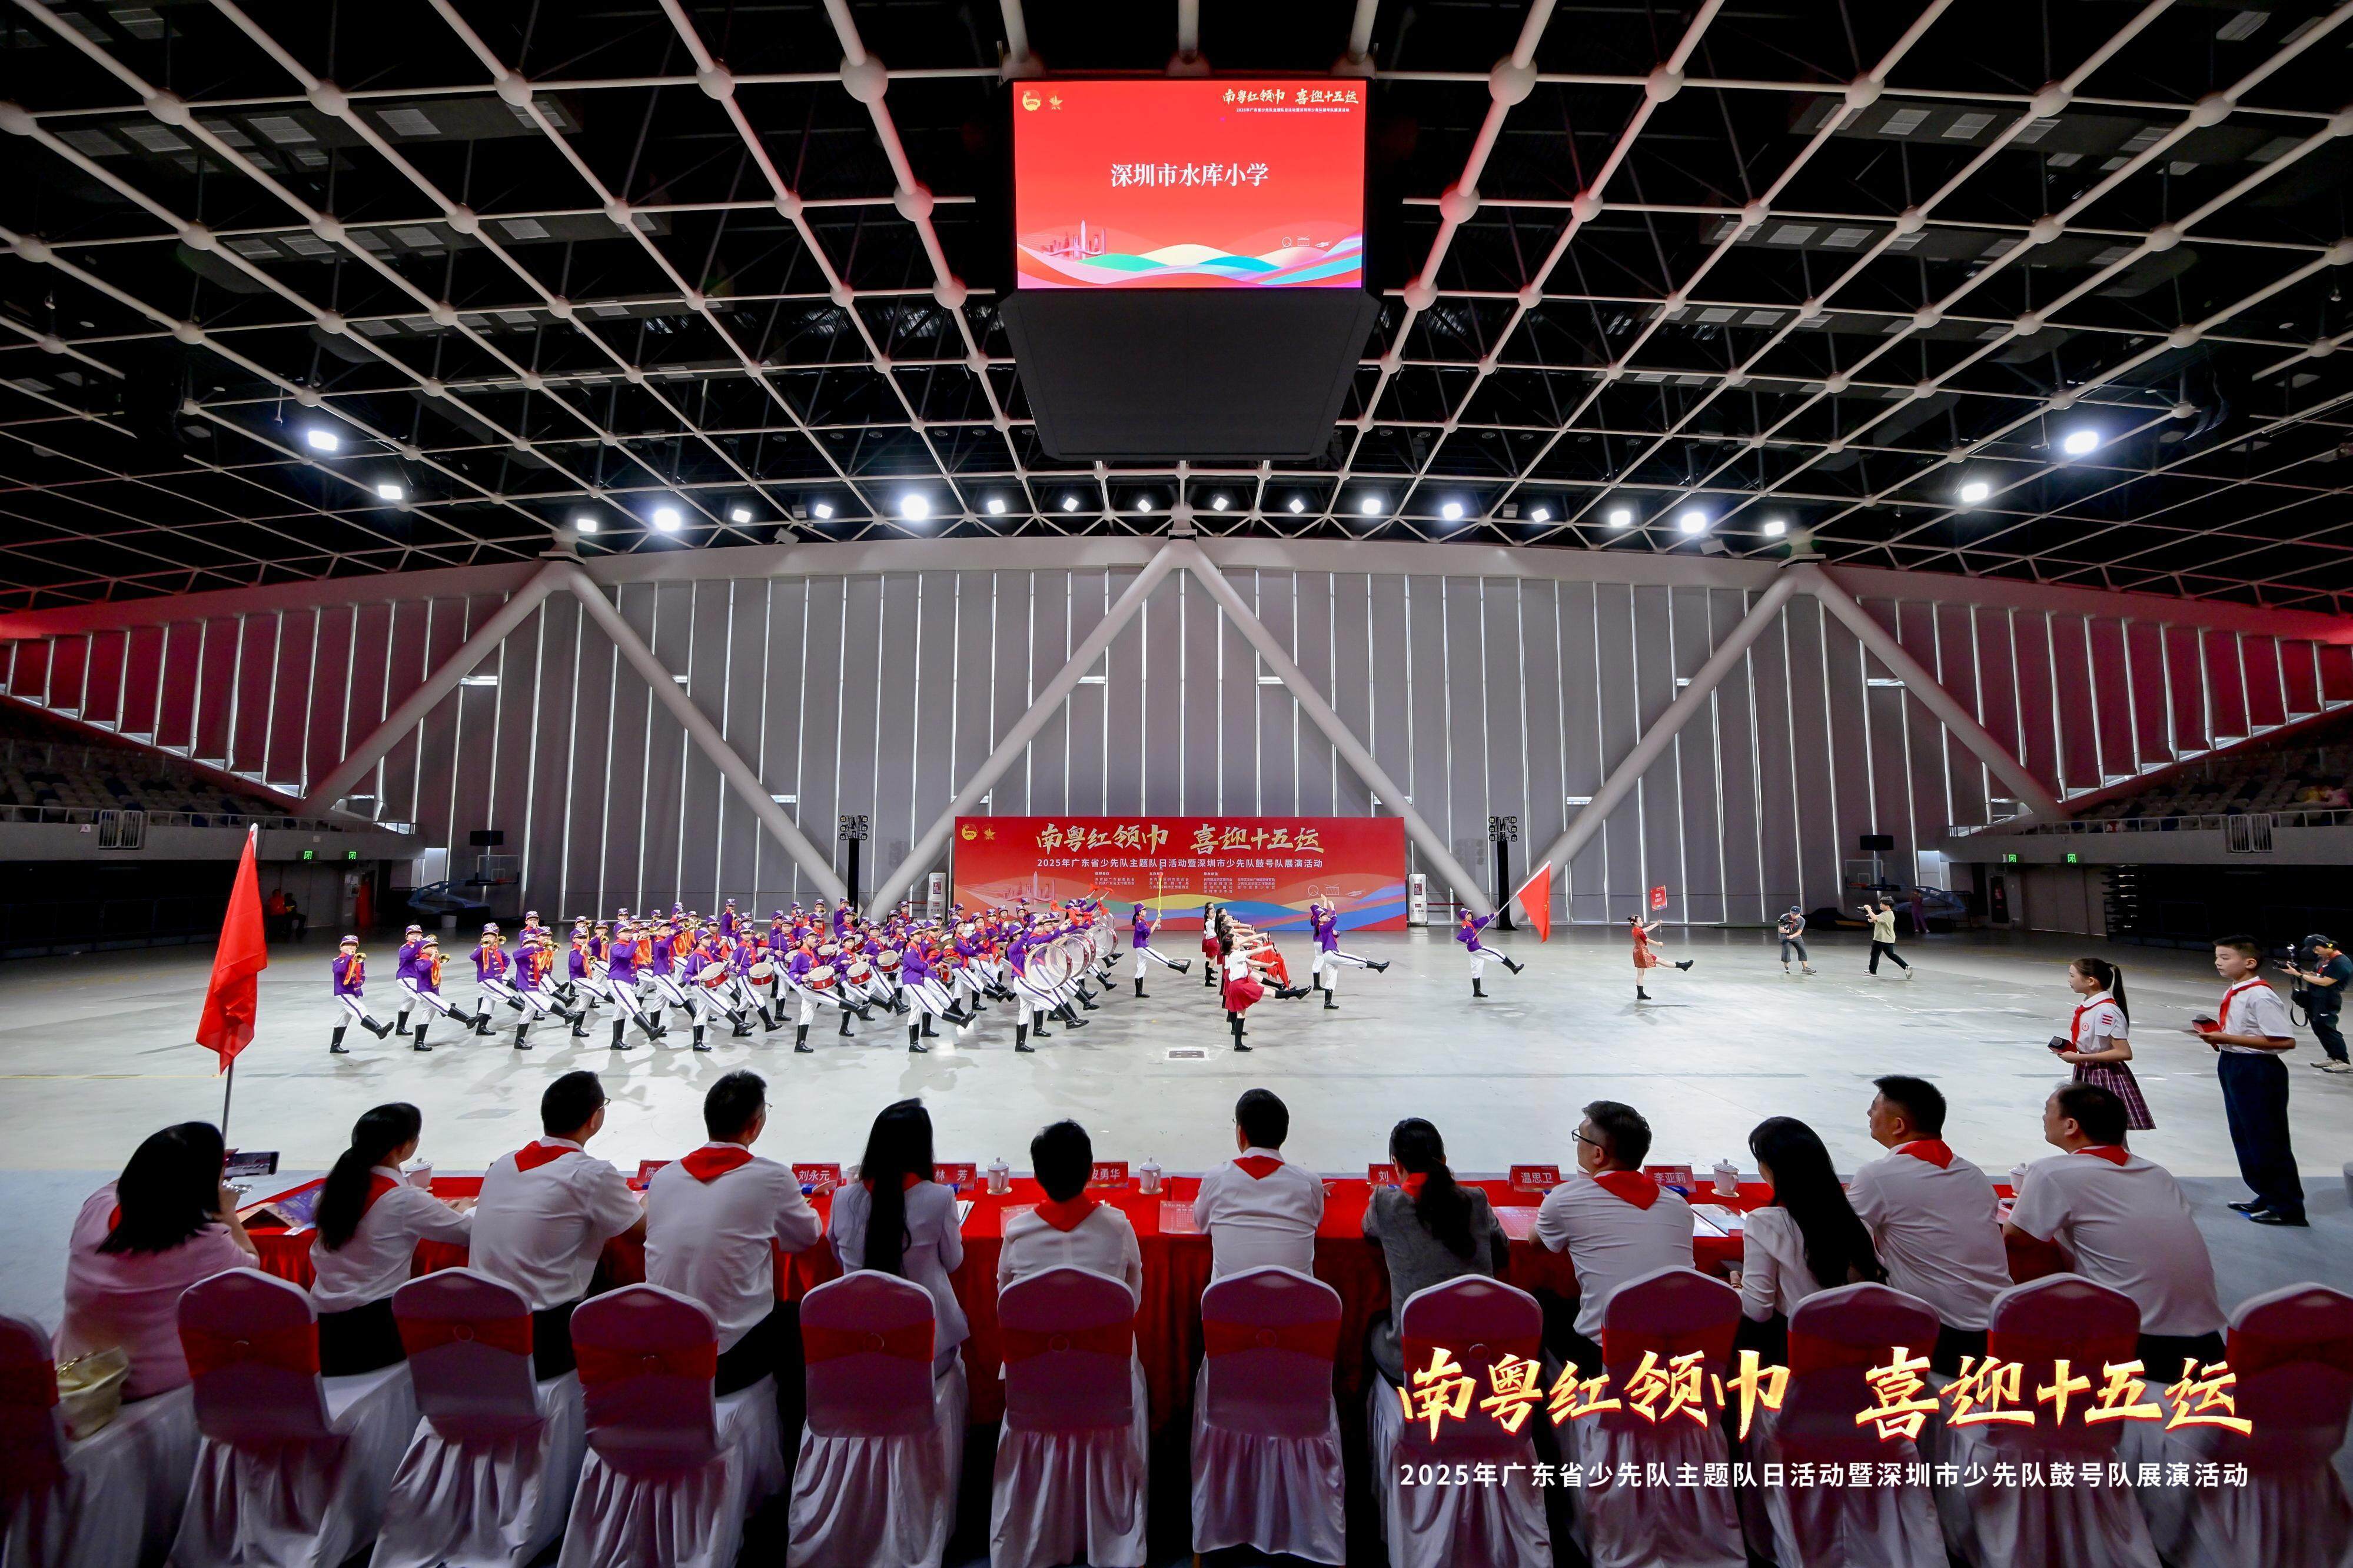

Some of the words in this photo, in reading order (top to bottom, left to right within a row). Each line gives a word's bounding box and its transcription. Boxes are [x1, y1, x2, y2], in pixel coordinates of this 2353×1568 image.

[1222, 88, 1285, 105] 南粤红领巾
[1295, 88, 1359, 104] 喜迎十五运
[1111, 162, 1269, 188] 深圳市水库小学
[1036, 823, 1169, 855] 南粤红领巾
[1190, 823, 1325, 855] 喜迎十五运
[1036, 858, 1323, 868] 2025年广东省少先队主题队日活动暨深圳市少先队鼓号队展演活动
[797, 1170, 830, 1181] 刘永元
[1378, 1170, 1389, 1182] 刘
[1520, 1172, 1554, 1184] 温思卫
[1654, 1171, 1686, 1184] 李亚莉
